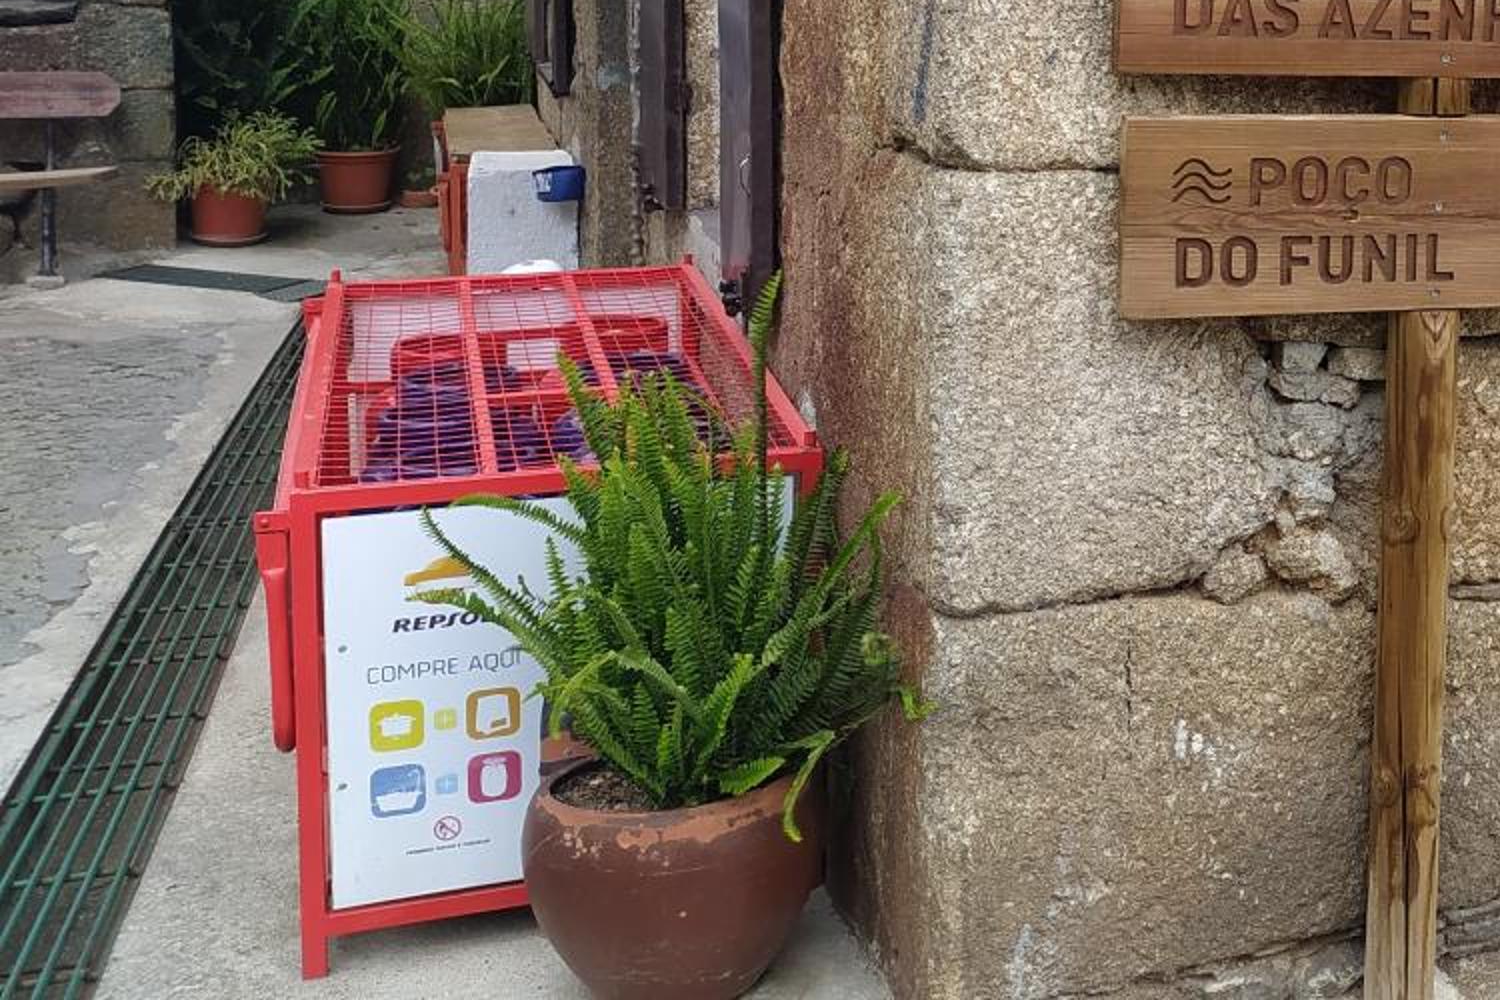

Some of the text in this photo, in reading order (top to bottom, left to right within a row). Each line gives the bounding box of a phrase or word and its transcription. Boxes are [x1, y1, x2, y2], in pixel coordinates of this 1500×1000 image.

[1250, 156, 1412, 222] POÇO
[1175, 233, 1454, 288] DO FUNIL
[367, 657, 459, 684] COMPRE
